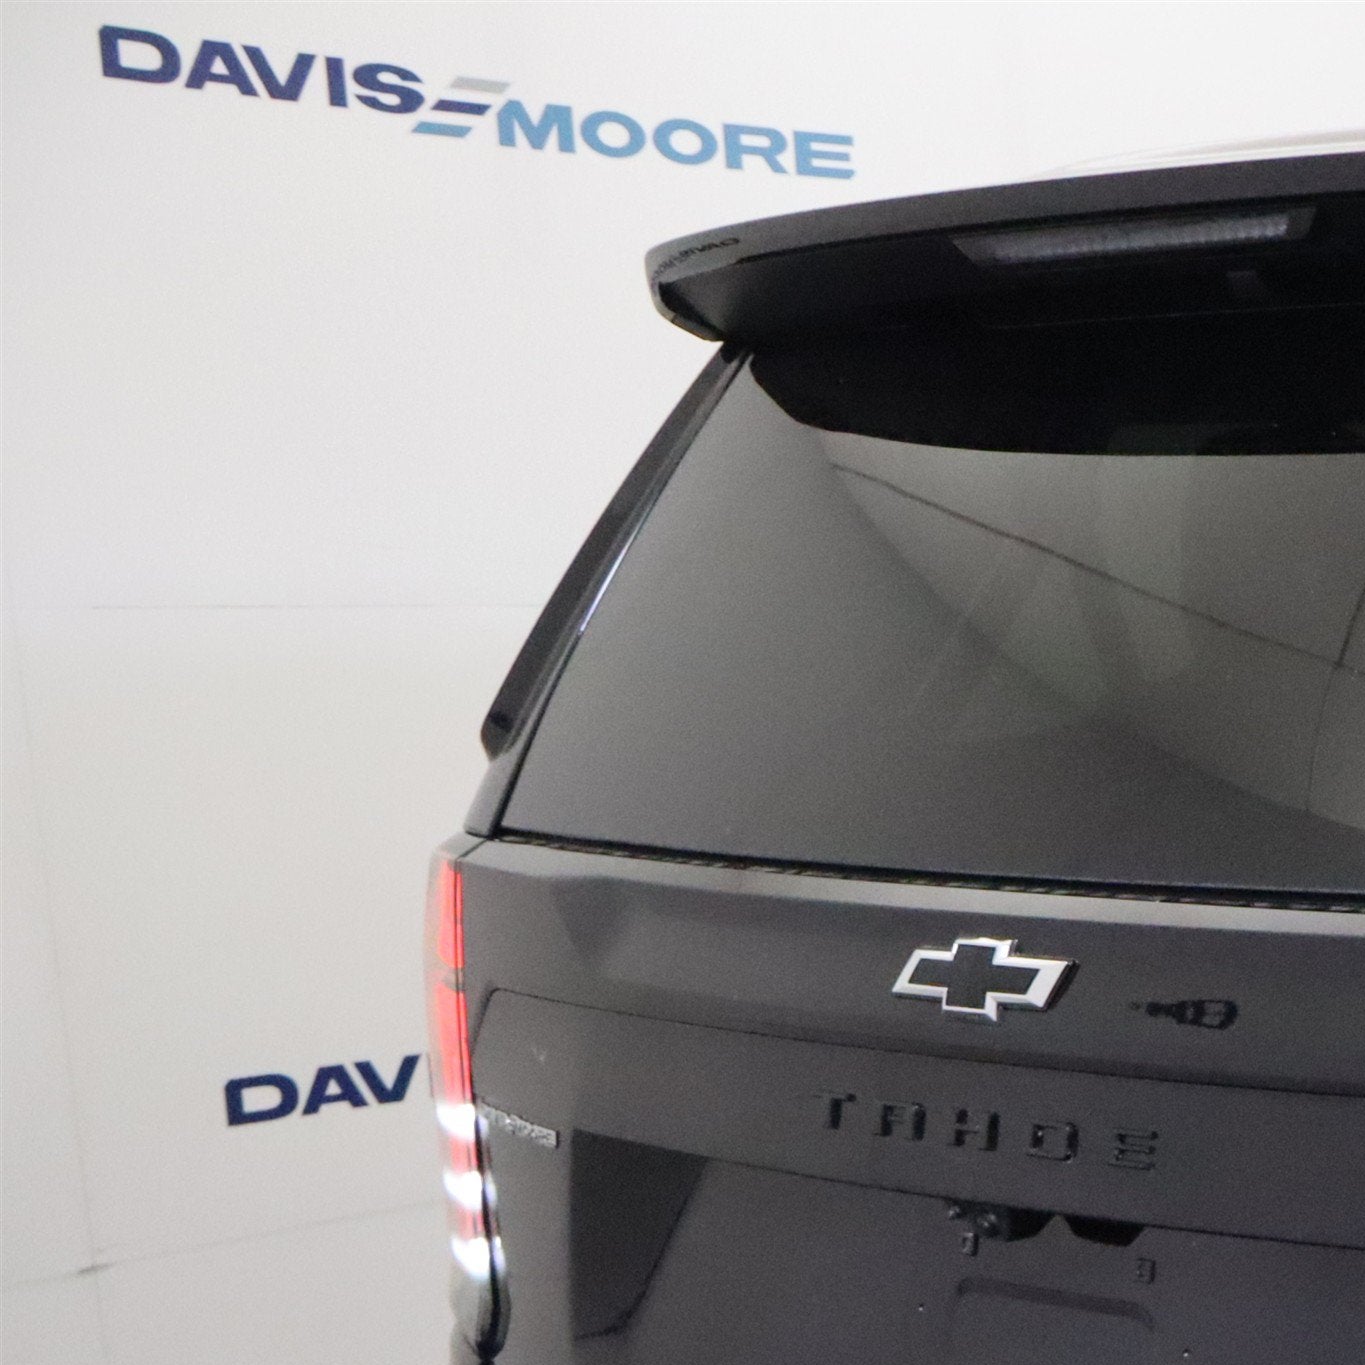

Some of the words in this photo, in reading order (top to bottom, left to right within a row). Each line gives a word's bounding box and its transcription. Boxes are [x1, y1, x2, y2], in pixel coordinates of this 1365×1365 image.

[97, 25, 426, 114] DAVIS
[497, 99, 856, 180] MOORE
[224, 1053, 421, 1127] DAV
[814, 1089, 1160, 1172] TAHOE
